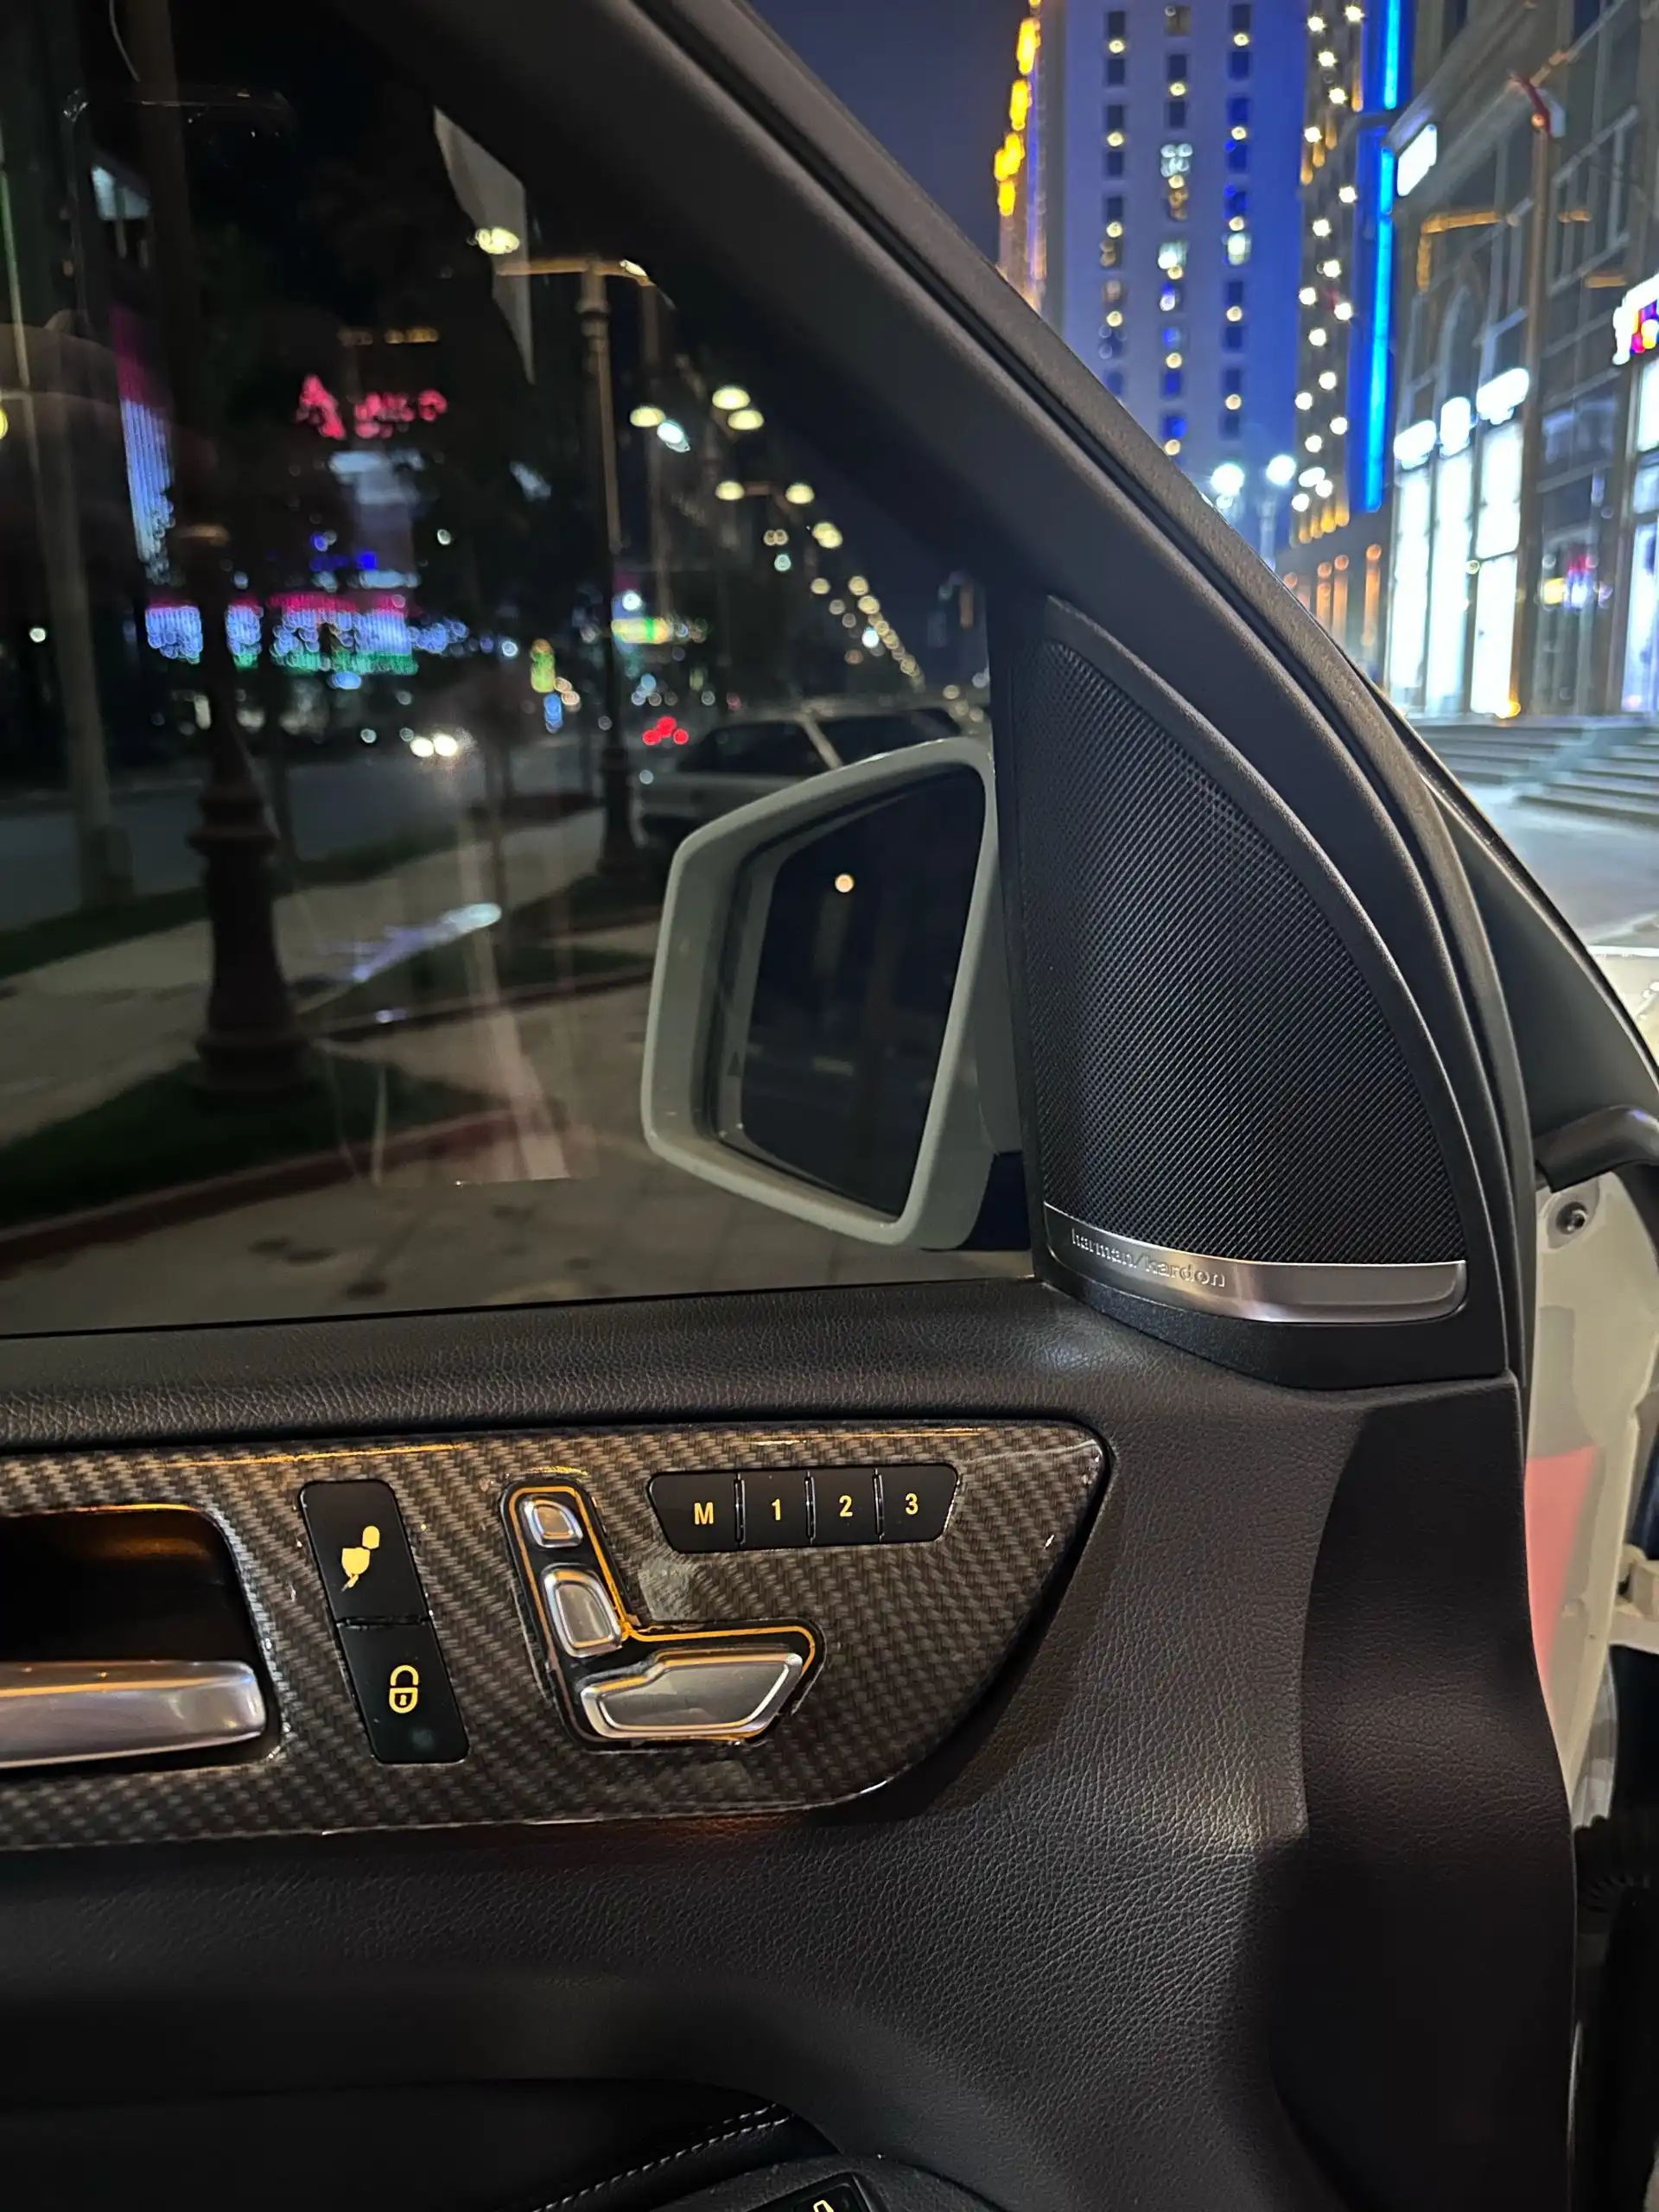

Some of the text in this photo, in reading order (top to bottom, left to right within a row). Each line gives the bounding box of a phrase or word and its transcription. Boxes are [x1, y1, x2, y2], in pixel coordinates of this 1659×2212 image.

[1071, 1227, 1225, 1287] harman/kardon
[694, 1492, 918, 1525] M 1 2 3
